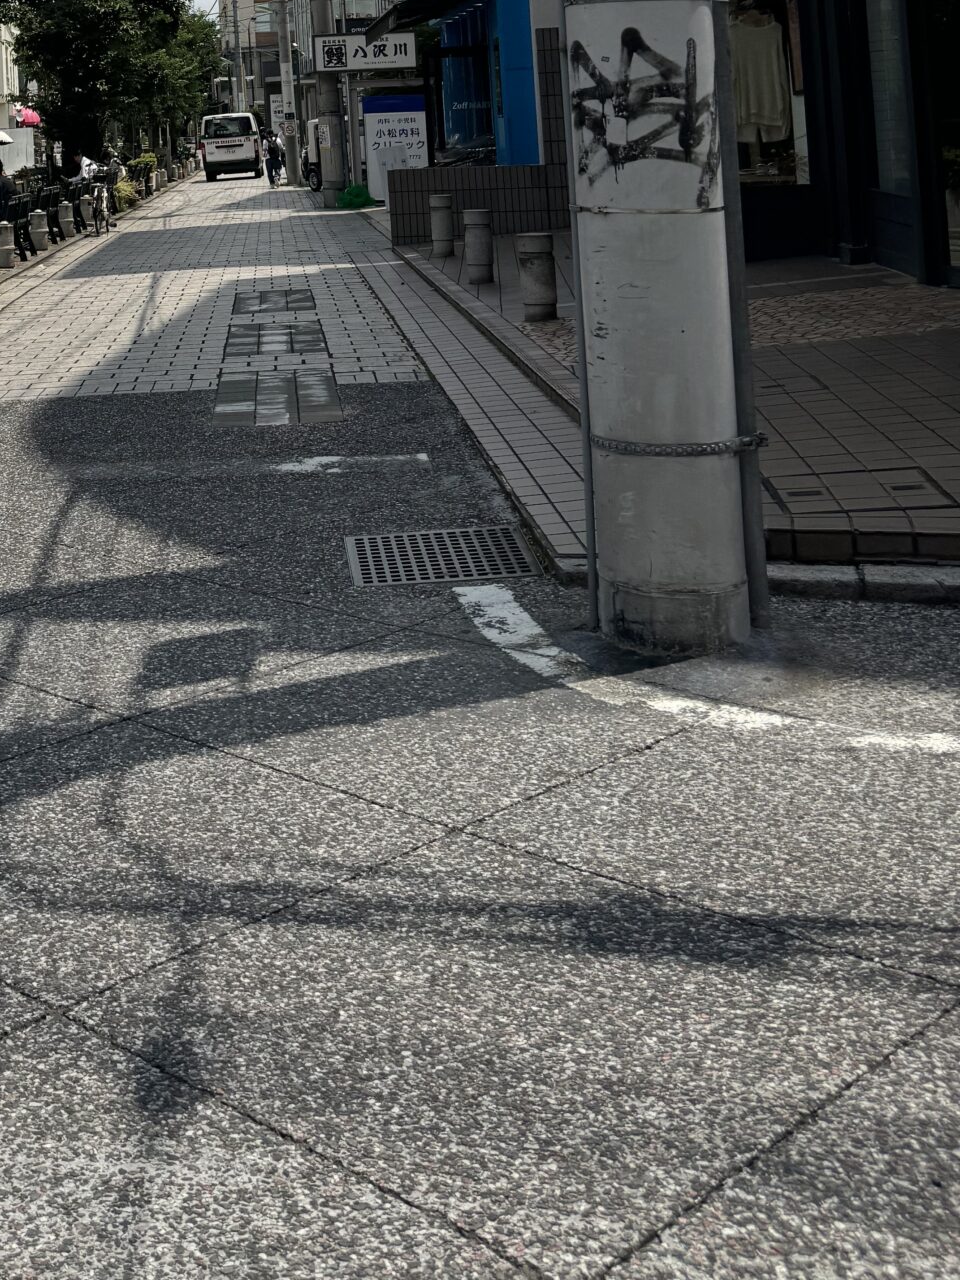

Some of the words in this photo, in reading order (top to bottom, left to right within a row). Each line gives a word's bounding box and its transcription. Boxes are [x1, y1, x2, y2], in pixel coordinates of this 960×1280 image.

[352, 42, 407, 59] 八沢川
[452, 102, 468, 110] Zoff
[375, 127, 420, 139] 小松内科
